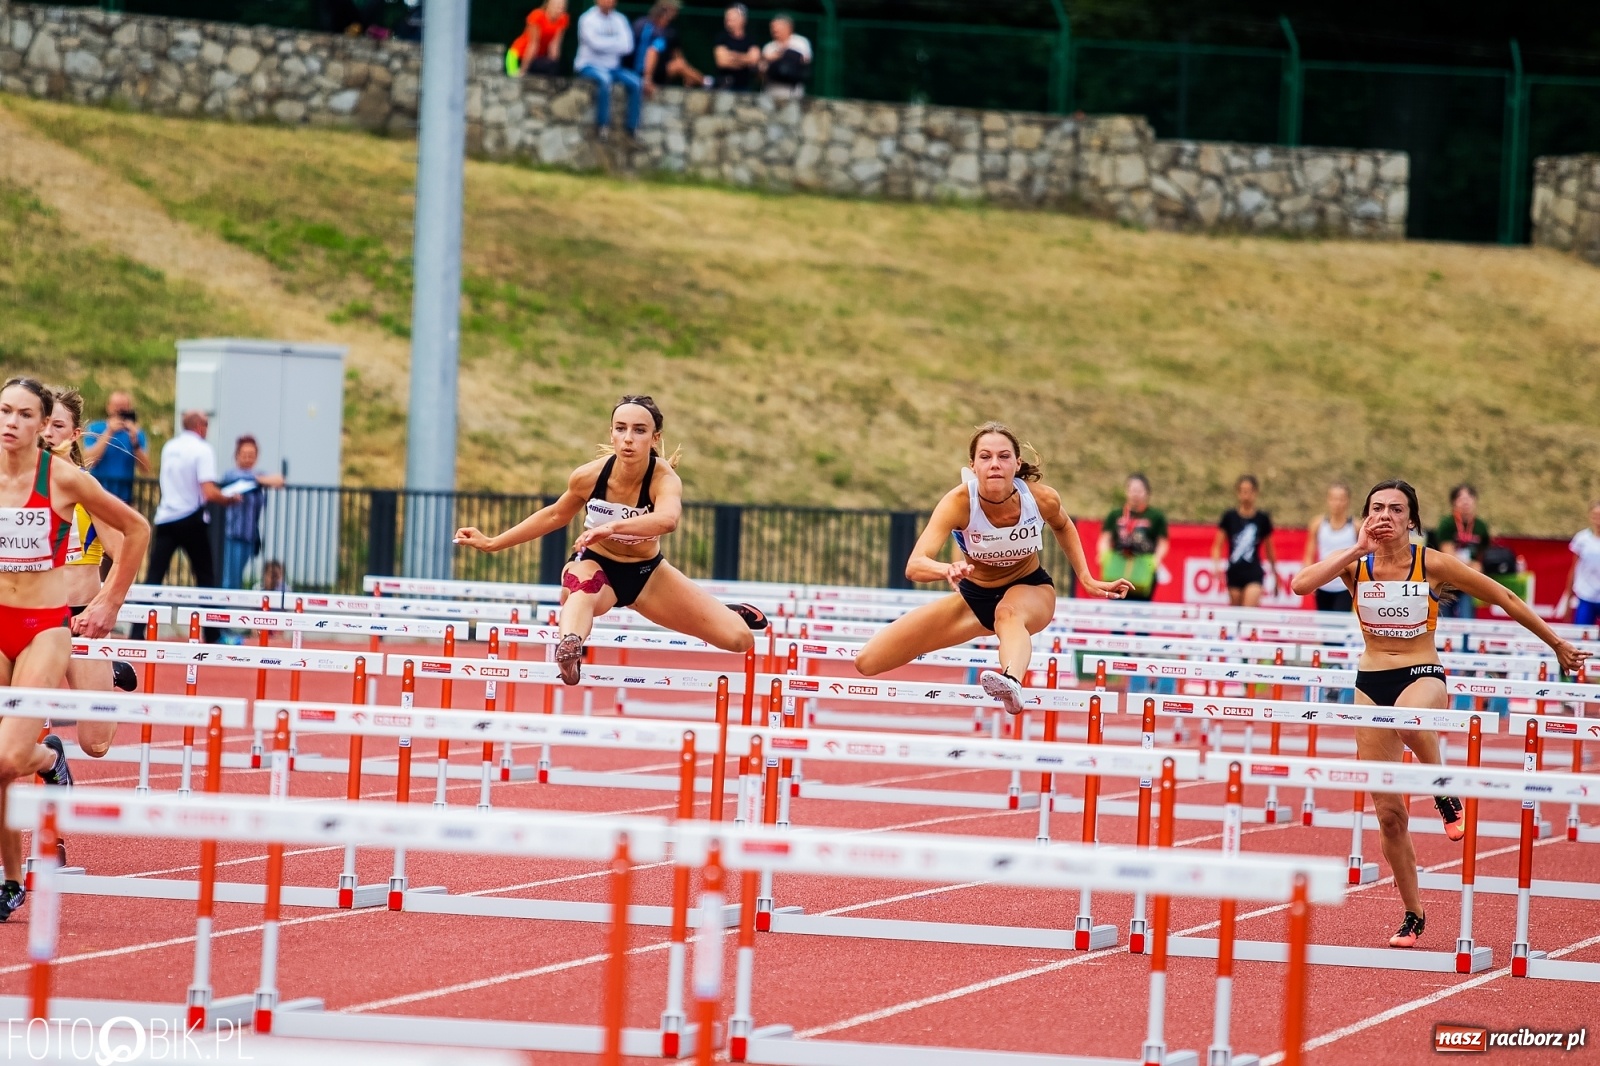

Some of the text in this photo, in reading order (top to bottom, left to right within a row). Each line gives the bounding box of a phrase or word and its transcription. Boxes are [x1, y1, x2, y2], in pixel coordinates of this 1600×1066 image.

[15, 511, 46, 526] 395
[1009, 525, 1039, 541] 601
[0, 536, 40, 549] RYLUK
[972, 545, 1040, 560] WESOŁOWSKA
[1401, 583, 1421, 597] 11
[1377, 607, 1410, 618] GOSS
[315, 620, 328, 628] 4F
[1404, 628, 1420, 637] 2019
[613, 635, 628, 643] 4F
[118, 649, 146, 658] ORLEN
[193, 652, 209, 662] 4F
[481, 668, 508, 677] ORLEN
[1225, 670, 1239, 678] 4F
[1410, 665, 1432, 676] NIKE
[849, 686, 877, 695] ORLEN
[924, 690, 941, 699] 4F
[1471, 685, 1550, 697] ORLEN 4F
[1224, 707, 1252, 716] ORLEN
[1301, 710, 1318, 720] 4F
